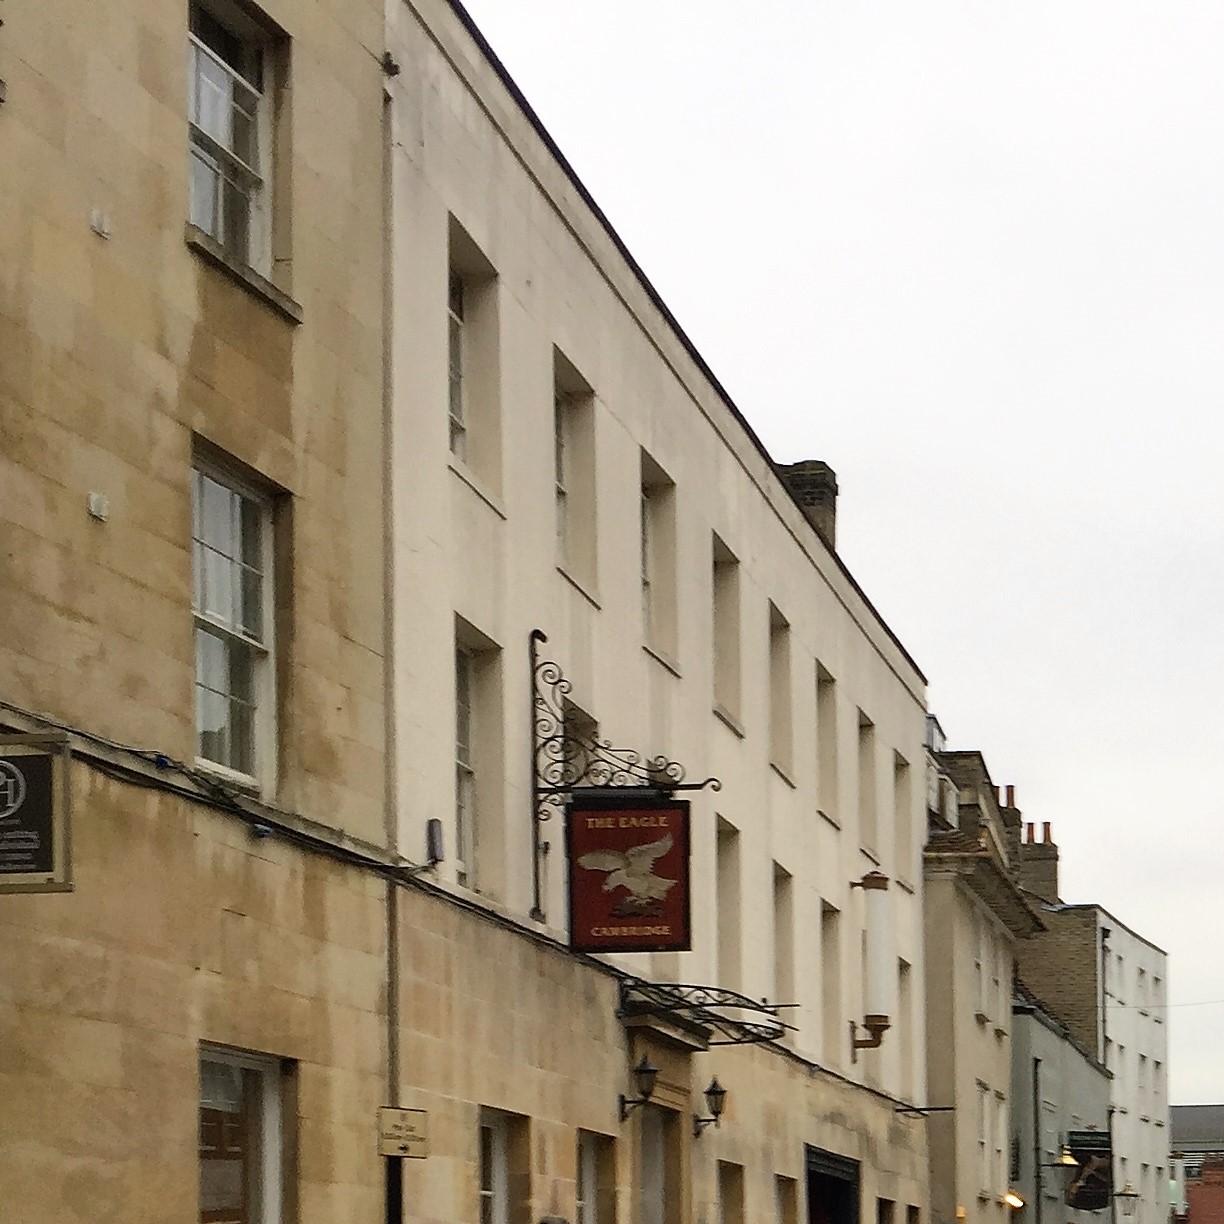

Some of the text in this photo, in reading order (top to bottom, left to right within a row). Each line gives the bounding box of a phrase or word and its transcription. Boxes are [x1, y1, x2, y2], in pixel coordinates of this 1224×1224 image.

[585, 816, 670, 829] THE EAGLE
[590, 925, 672, 937] CAMBRIDGE
